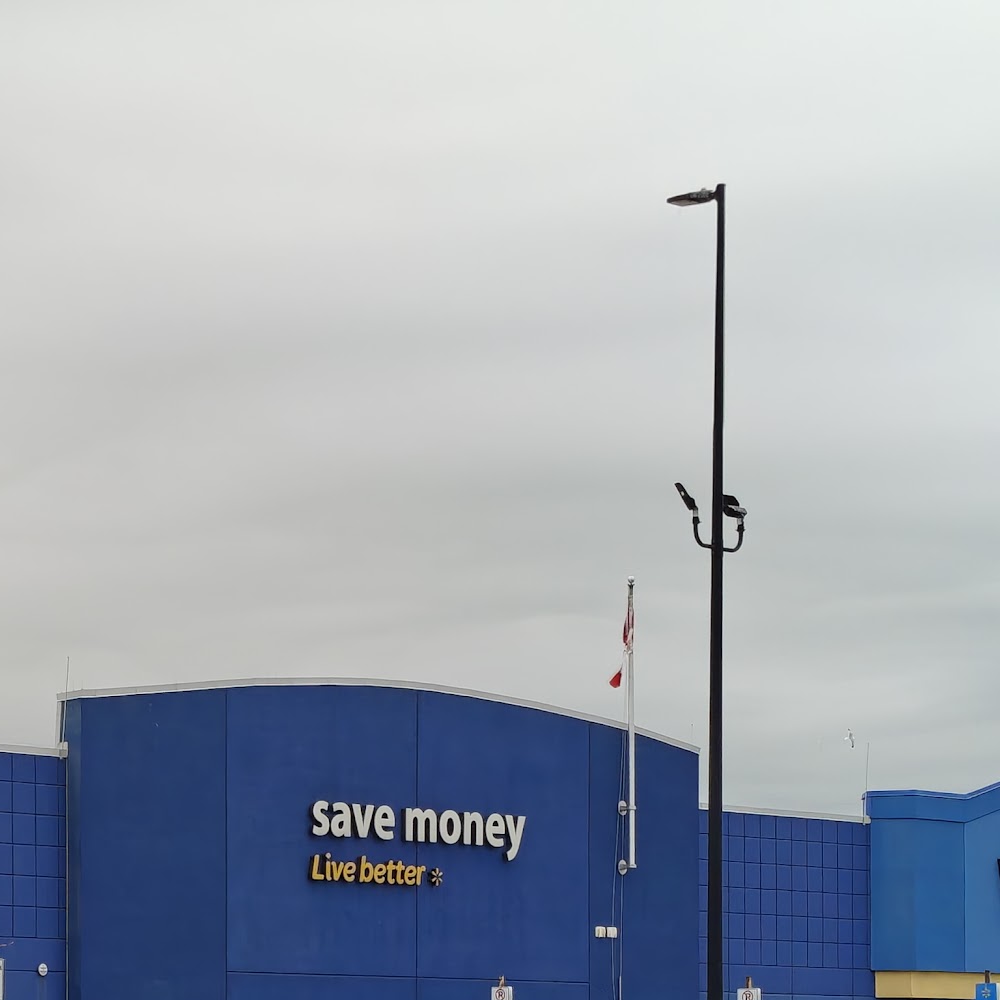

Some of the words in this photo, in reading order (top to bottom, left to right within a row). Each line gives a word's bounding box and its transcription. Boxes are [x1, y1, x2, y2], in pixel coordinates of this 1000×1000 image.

[311, 800, 396, 840] save
[404, 807, 527, 861] money
[311, 853, 357, 882] Live
[358, 855, 426, 886] better
